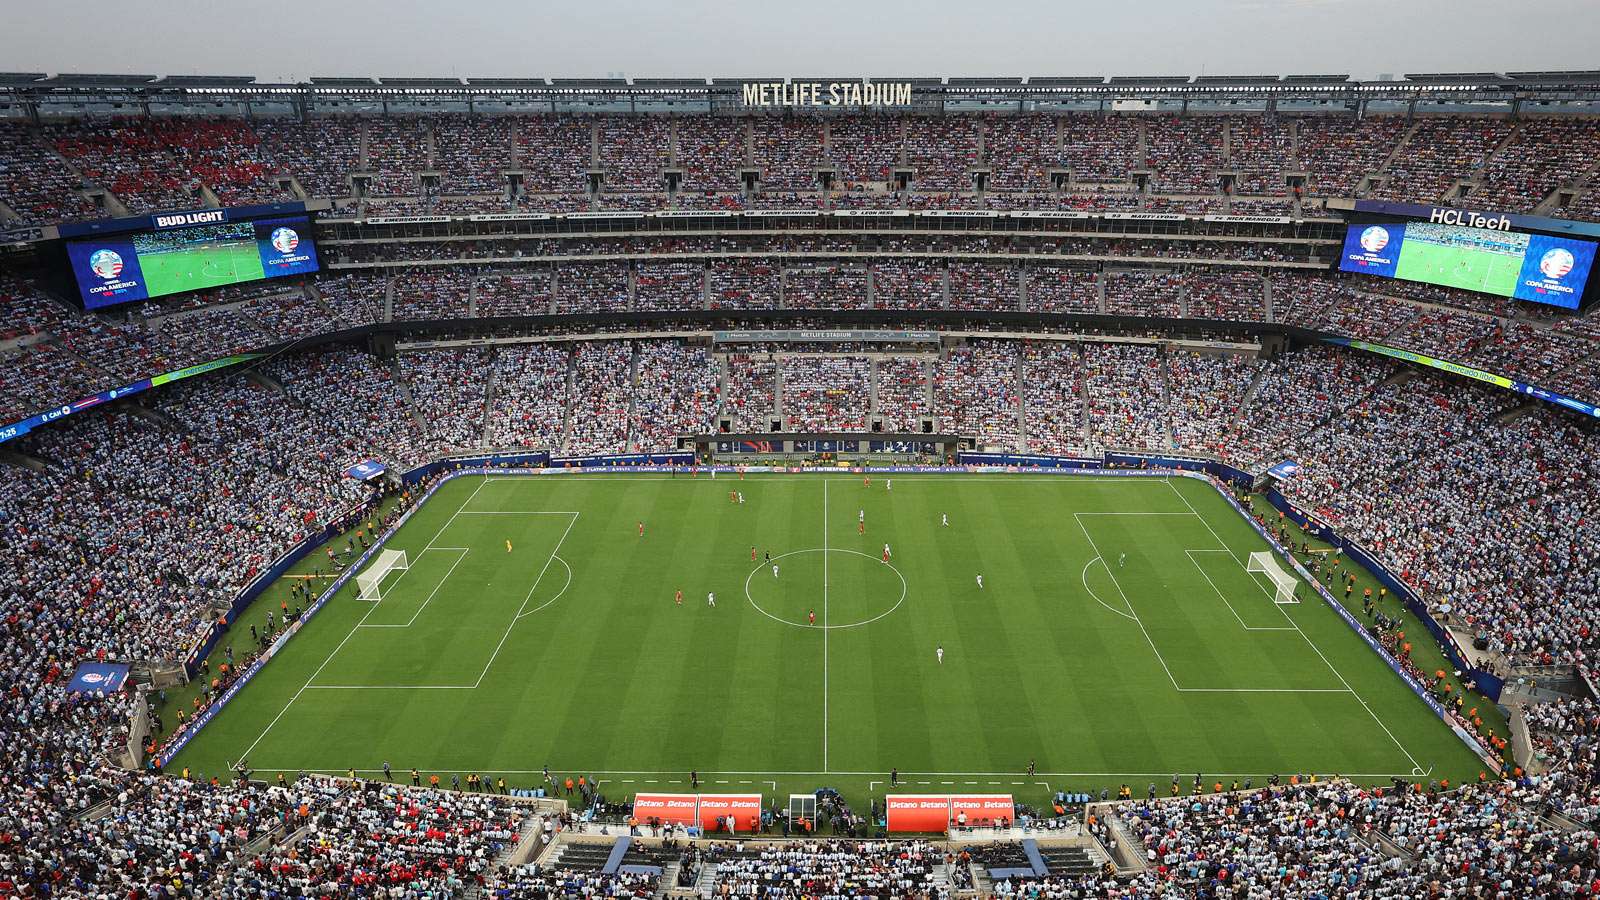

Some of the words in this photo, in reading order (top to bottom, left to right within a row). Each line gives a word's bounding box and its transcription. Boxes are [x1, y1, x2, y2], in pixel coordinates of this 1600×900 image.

[743, 83, 822, 105] METLIFE
[829, 83, 911, 105] STADIUM
[157, 216, 186, 227] BUD
[186, 211, 224, 223] LIGHT
[1446, 364, 1479, 377] mercado
[1479, 371, 1496, 382] libre
[1381, 651, 1394, 665] DELTA
[246, 664, 259, 679] DELTA
[1402, 672, 1418, 690] LATAM
[223, 685, 239, 703] LATAM
[1426, 696, 1441, 713] DELTA
[197, 712, 212, 728] DELTA
[168, 736, 188, 758] LATAM
